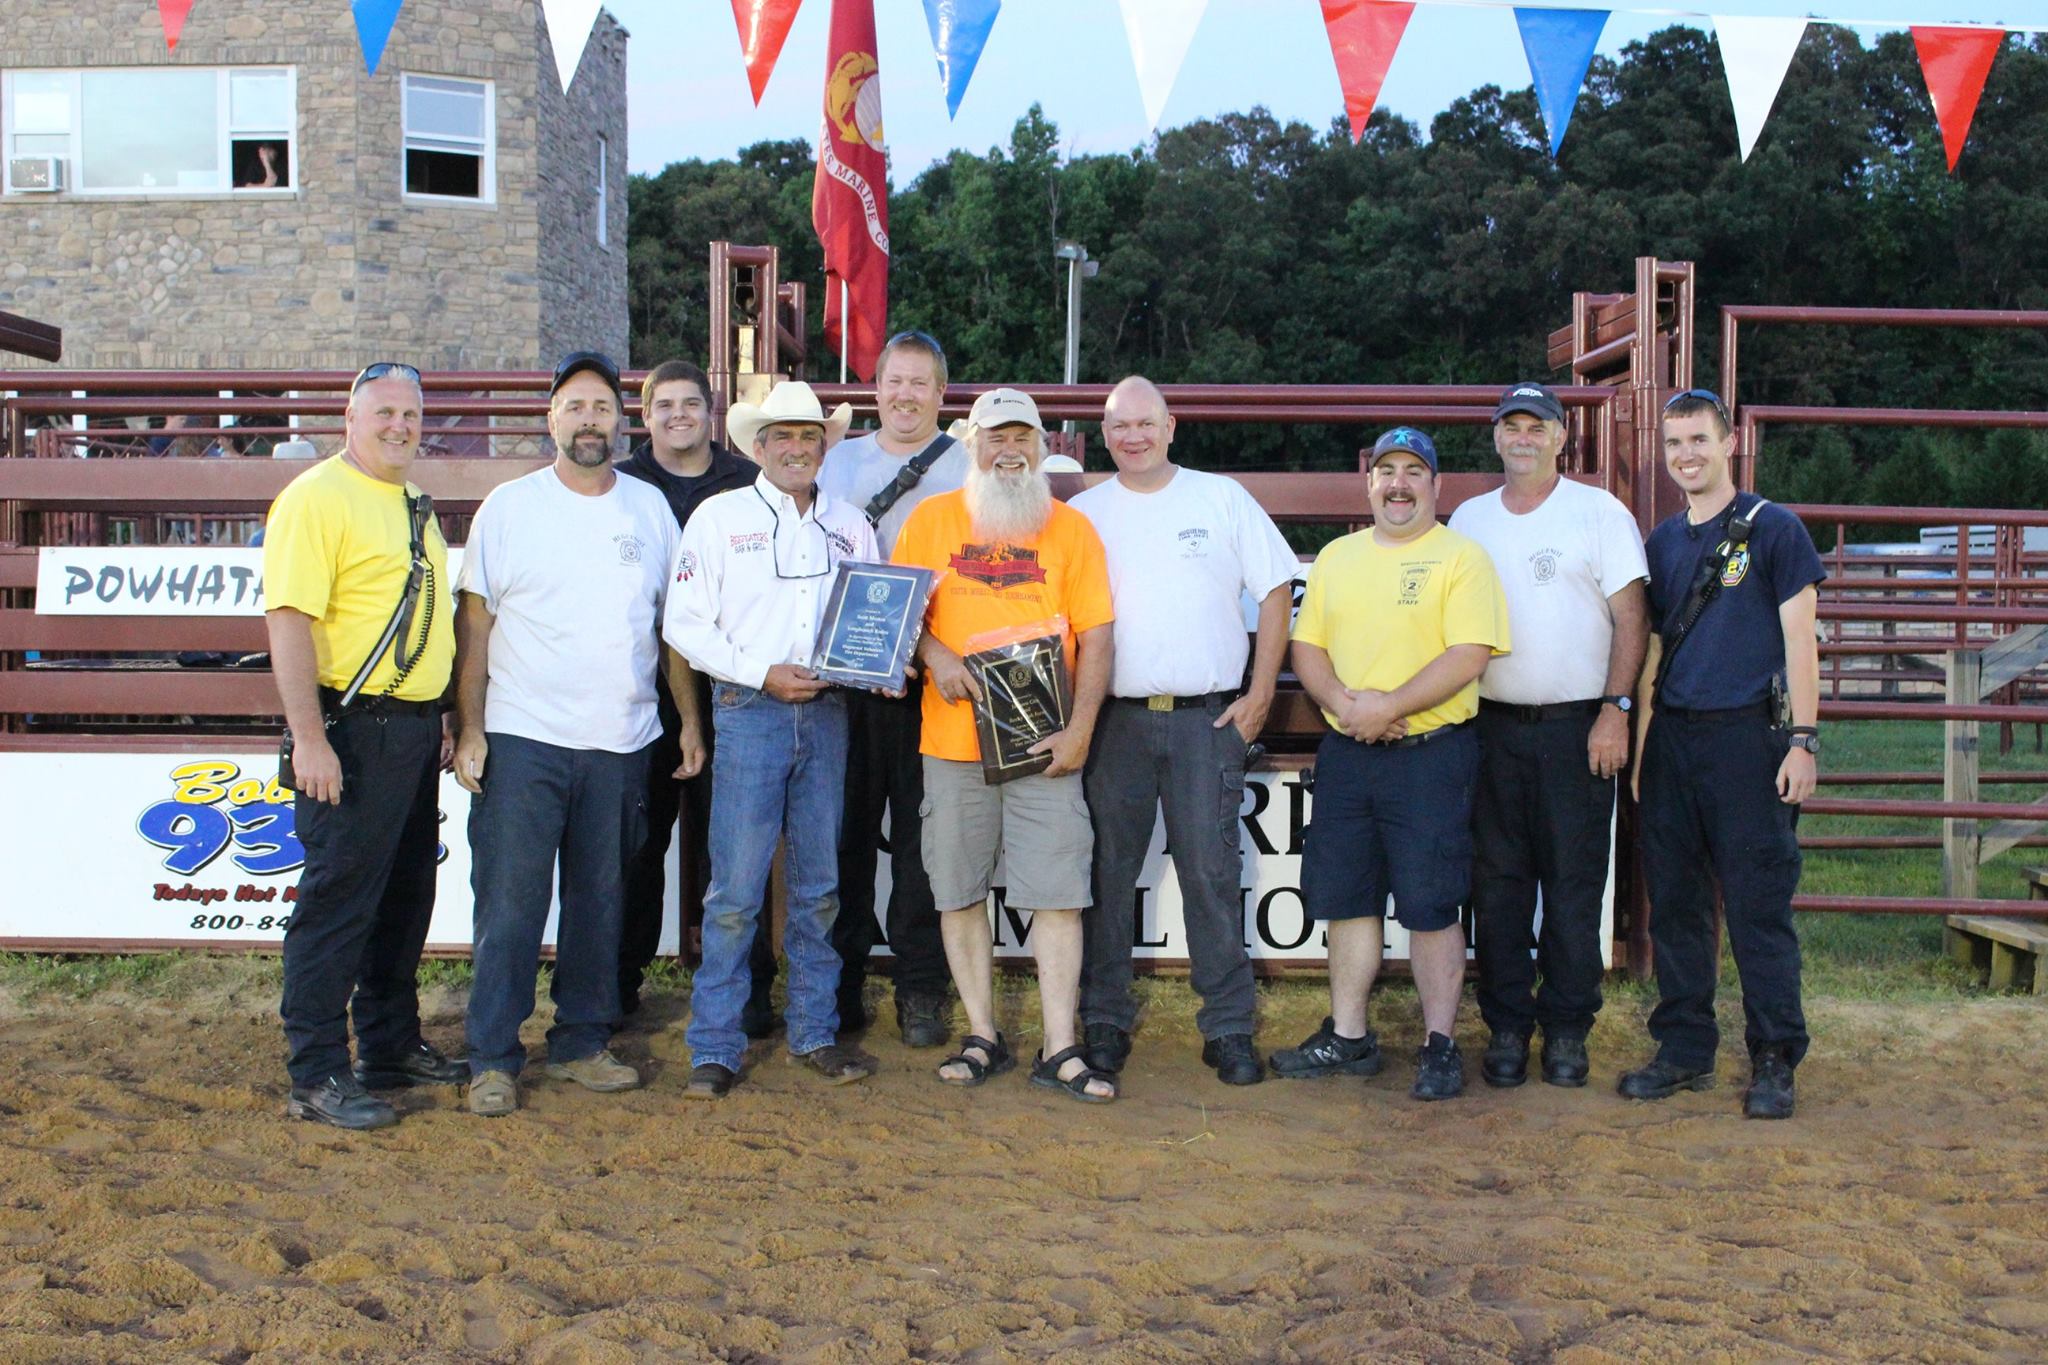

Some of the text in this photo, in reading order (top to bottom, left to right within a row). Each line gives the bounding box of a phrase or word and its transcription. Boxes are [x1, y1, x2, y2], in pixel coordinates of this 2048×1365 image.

[834, 164, 877, 222] MARINE
[875, 231, 889, 250] CO
[1727, 561, 1738, 574] 2
[1408, 582, 1417, 590] 2
[171, 760, 295, 806] Bob
[136, 800, 306, 877] 93
[234, 884, 277, 902] Hot
[190, 914, 292, 931] 800-84
